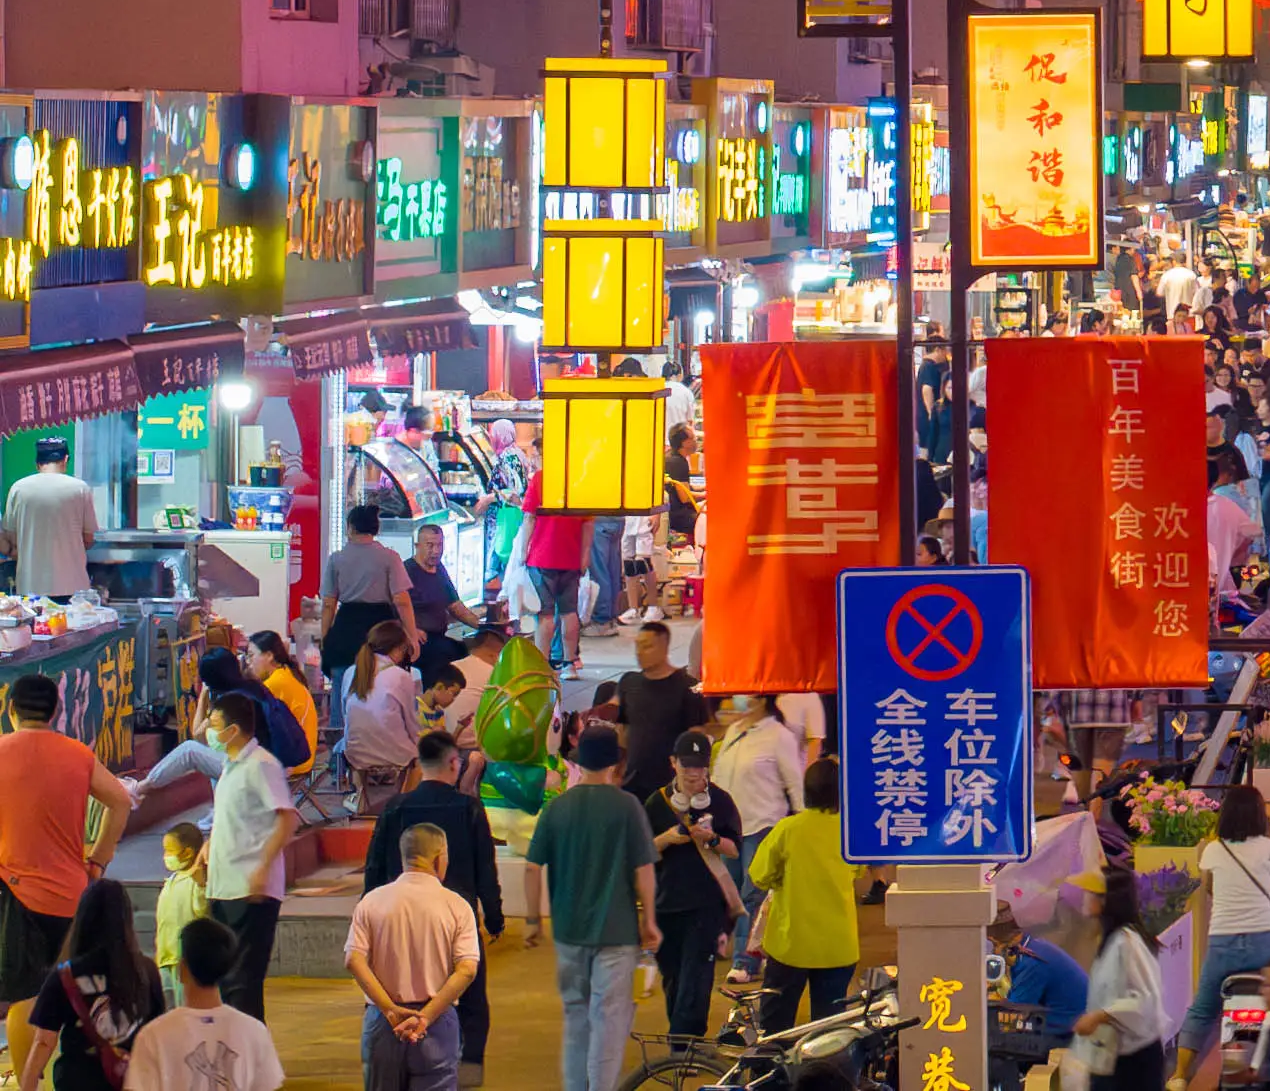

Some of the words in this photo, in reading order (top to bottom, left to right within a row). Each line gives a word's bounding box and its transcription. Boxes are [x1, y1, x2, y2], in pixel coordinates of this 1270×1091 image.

[1023, 53, 1067, 187] 促和谐
[1106, 359, 1146, 590] 百年美食街
[1152, 501, 1191, 638] 欢迎您
[871, 687, 928, 848] 全线禁停
[943, 689, 998, 848] 车位除外
